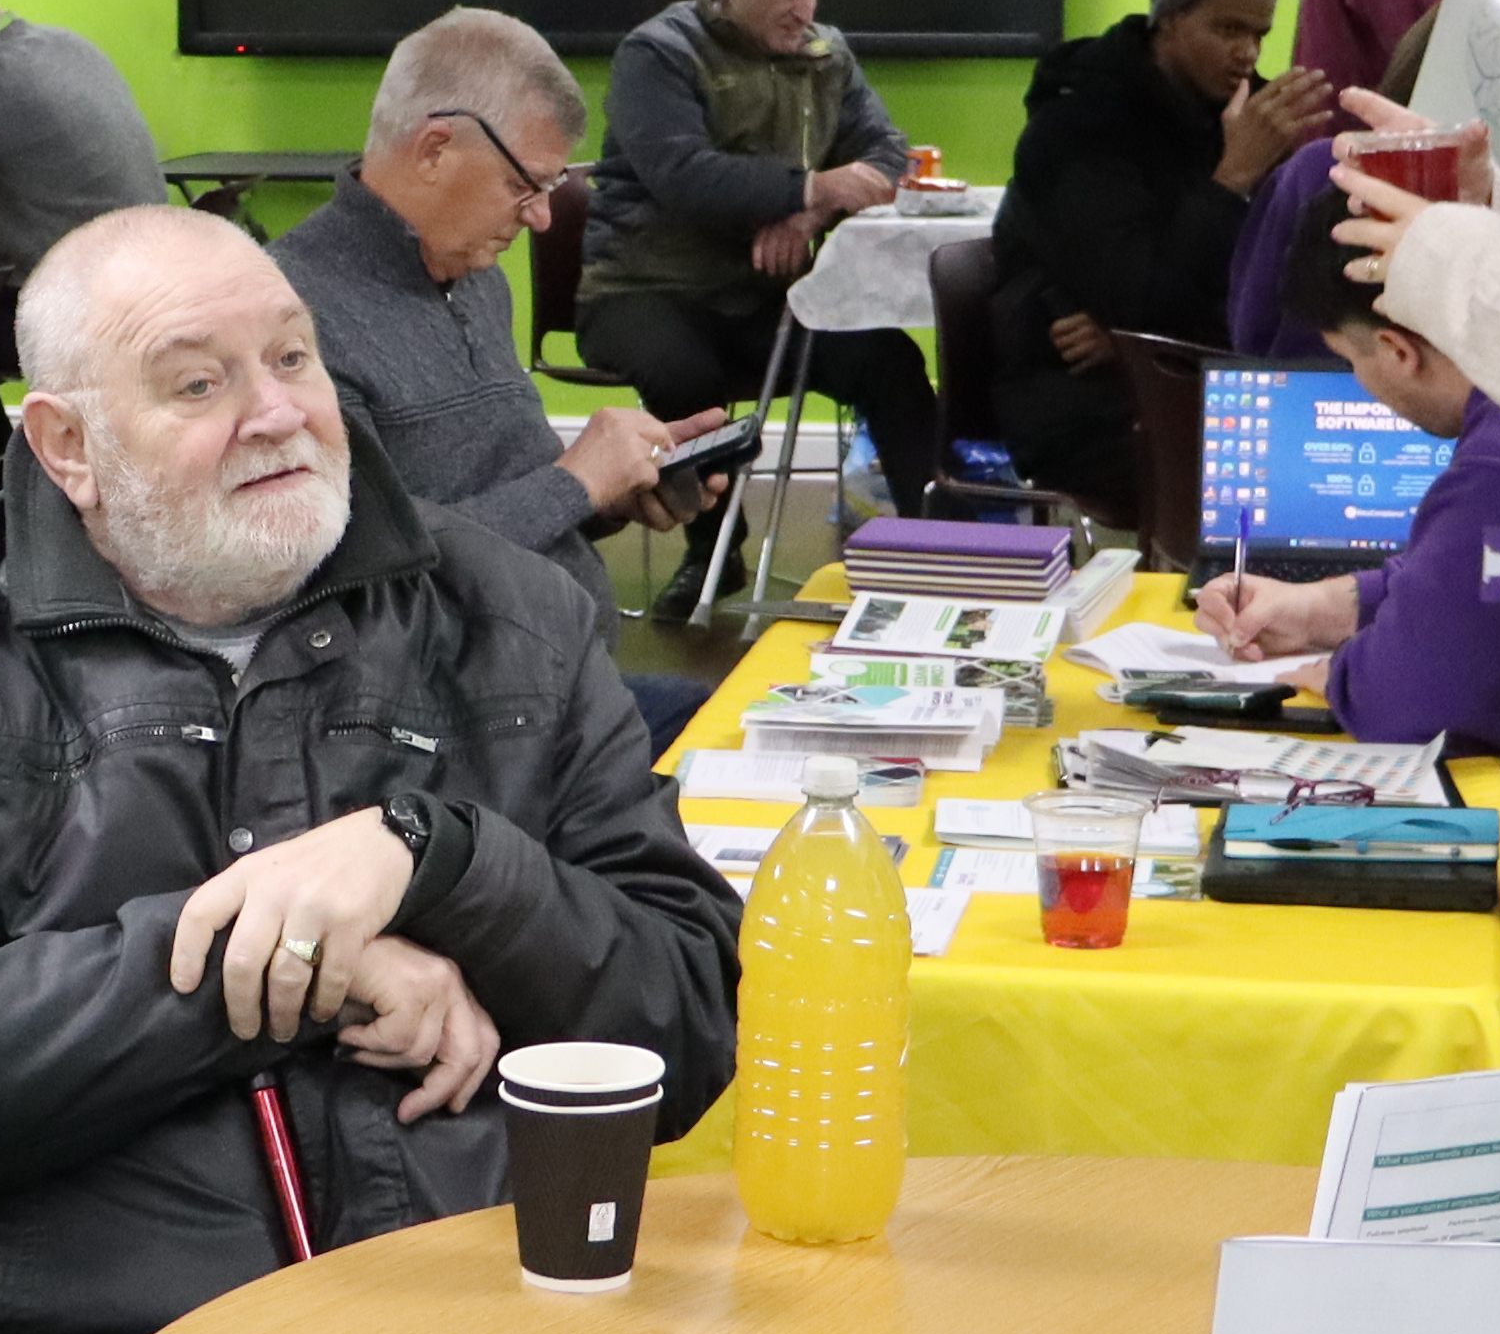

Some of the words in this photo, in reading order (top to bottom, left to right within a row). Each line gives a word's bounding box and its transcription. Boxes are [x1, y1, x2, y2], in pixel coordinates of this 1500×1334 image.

[1314, 401, 1343, 416] THE
[1344, 401, 1397, 416] IMPOR
[1316, 416, 1395, 431] SOFTWARE
[1396, 417, 1422, 431] UP
